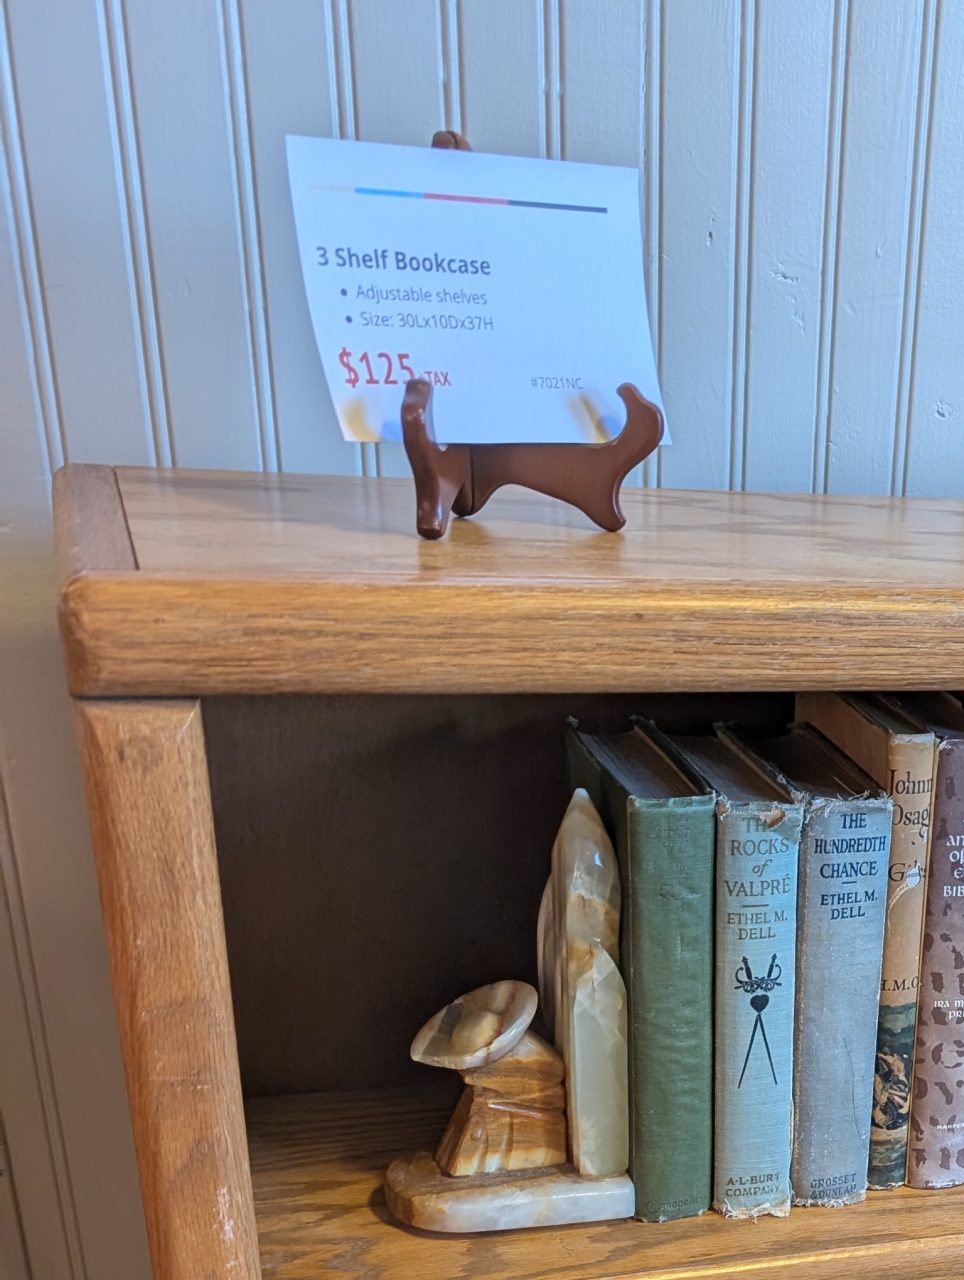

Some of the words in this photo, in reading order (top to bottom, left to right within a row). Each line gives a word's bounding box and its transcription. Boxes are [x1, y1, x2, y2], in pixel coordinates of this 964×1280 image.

[316, 246, 329, 266] 3
[335, 247, 388, 269] Shelf
[395, 251, 491, 275] Bookcase
[356, 285, 432, 304] Adjustable
[436, 288, 487, 305] shelves
[360, 312, 394, 327] Size:
[398, 313, 494, 330] 30Lx10Dx37H
[338, 347, 415, 388] $125
[419, 370, 452, 386] TAX
[840, 812, 867, 829] THE
[730, 838, 789, 856] ROCKS
[814, 835, 886, 855] HUNDREDTH
[752, 859, 772, 877] of
[819, 861, 878, 878] CHANCE
[725, 873, 791, 896] VALPRÉ
[820, 892, 861, 906] ETHEL
[864, 890, 878, 902] M.
[727, 912, 771, 925] ETHEL
[774, 909, 788, 921] M.
[830, 905, 865, 921] DELL
[738, 926, 776, 940] DELL
[934, 1000, 950, 1008] IRA
[810, 1172, 857, 1188] GROSSET
[725, 1184, 779, 1197] COMPANY
